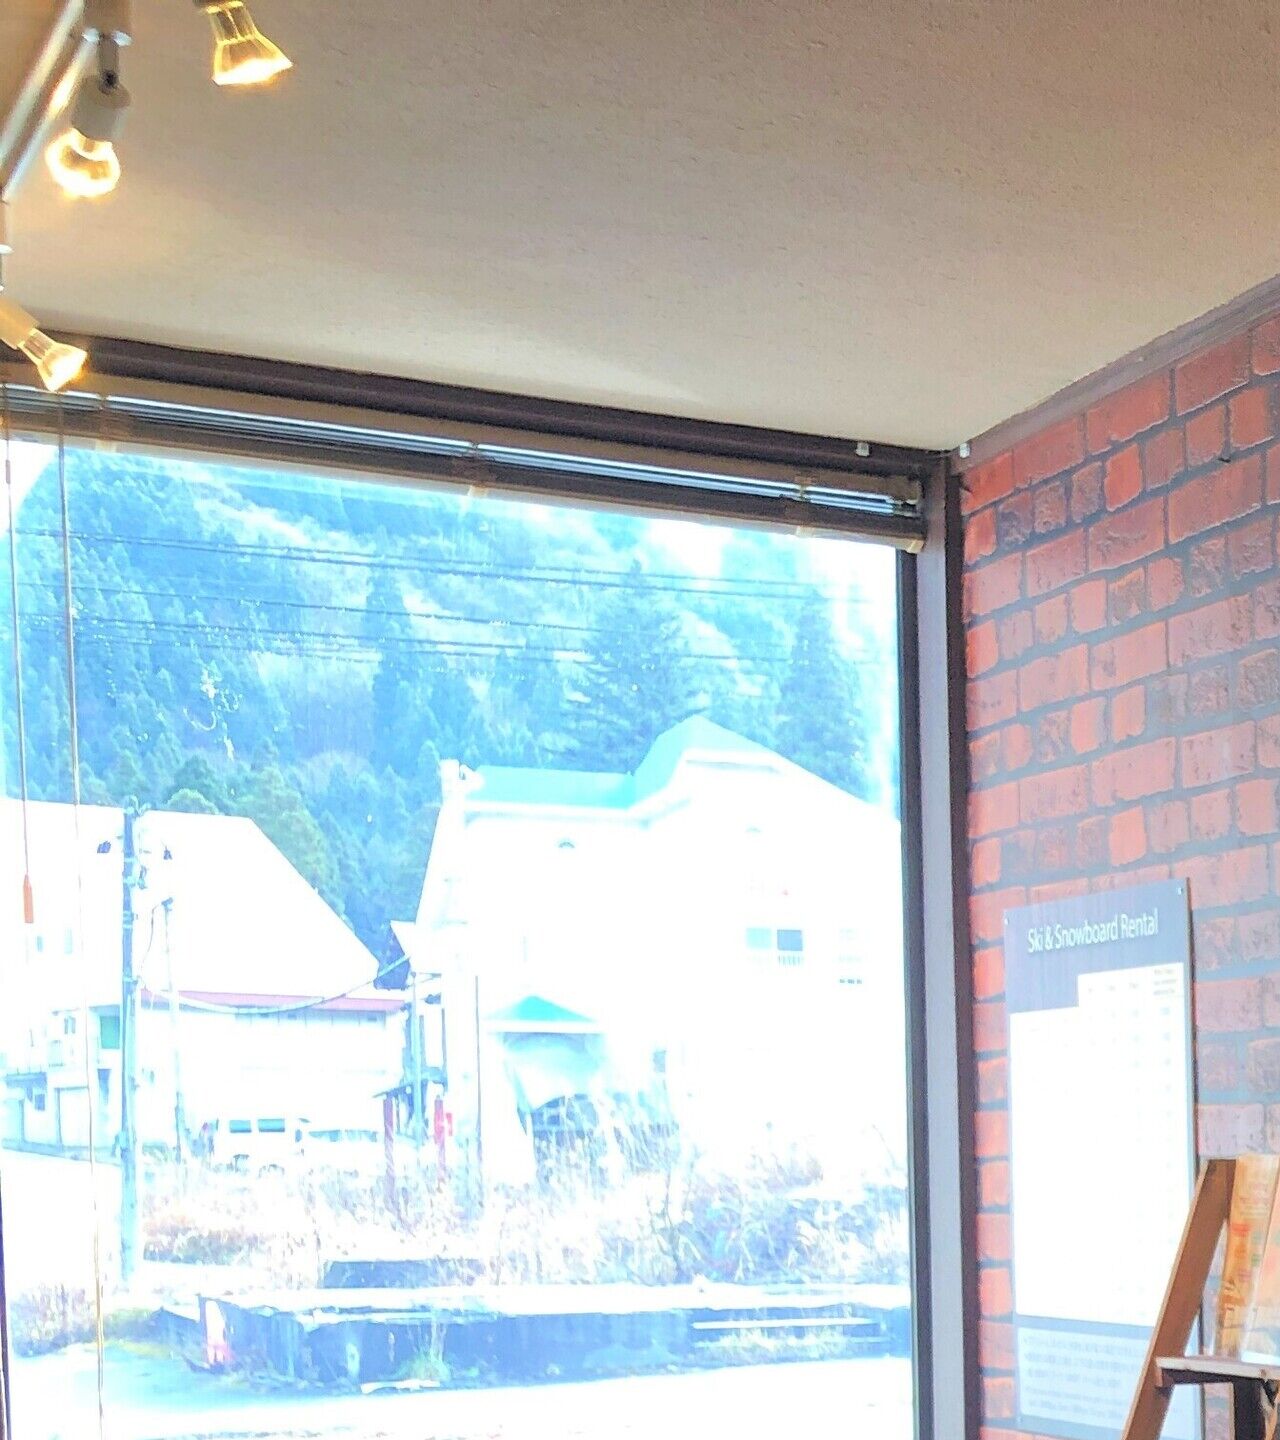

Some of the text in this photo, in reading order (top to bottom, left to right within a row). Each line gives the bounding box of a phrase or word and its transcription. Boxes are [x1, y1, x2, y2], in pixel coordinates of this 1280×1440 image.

[1027, 907, 1159, 953] Ski & Snowboard Rental
